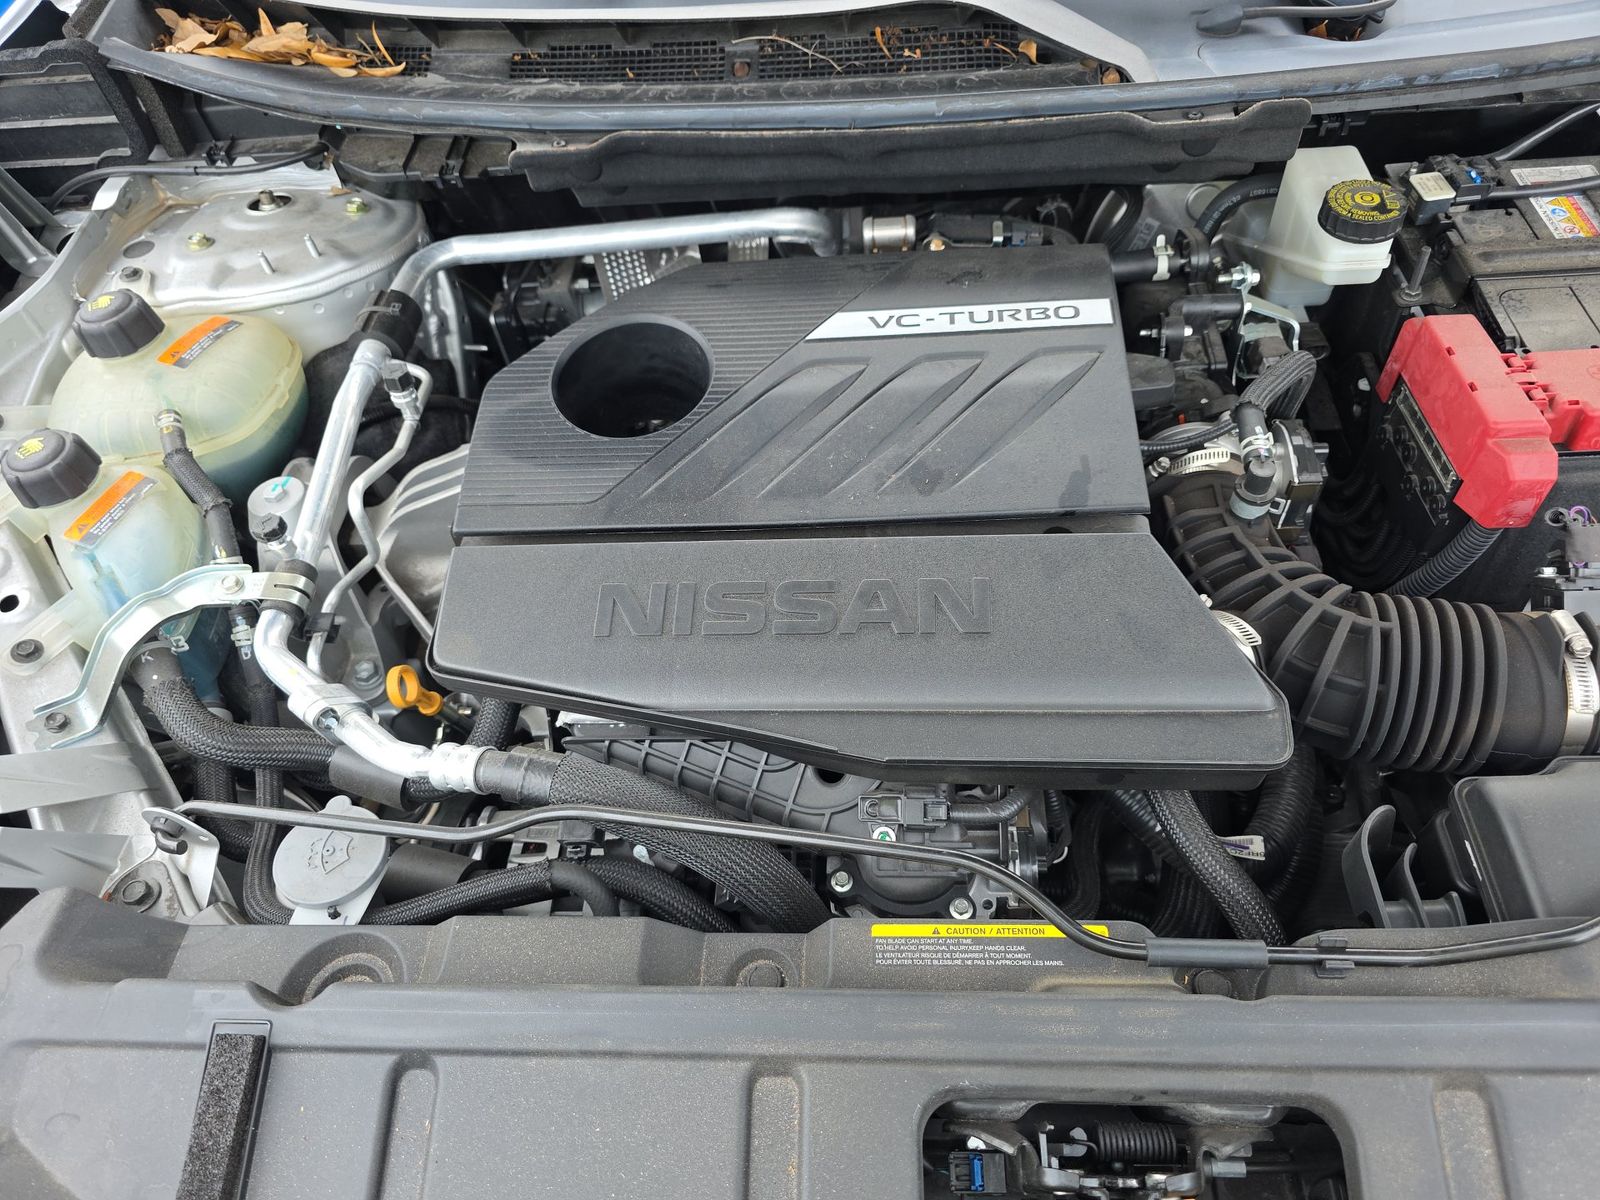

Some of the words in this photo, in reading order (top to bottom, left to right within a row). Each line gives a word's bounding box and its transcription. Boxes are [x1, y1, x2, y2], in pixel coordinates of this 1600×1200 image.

[868, 305, 1081, 329] VC-TURBO
[592, 577, 992, 638] NISSAN
[946, 927, 986, 935] CAUTION
[996, 927, 1046, 935] ATTENTION
